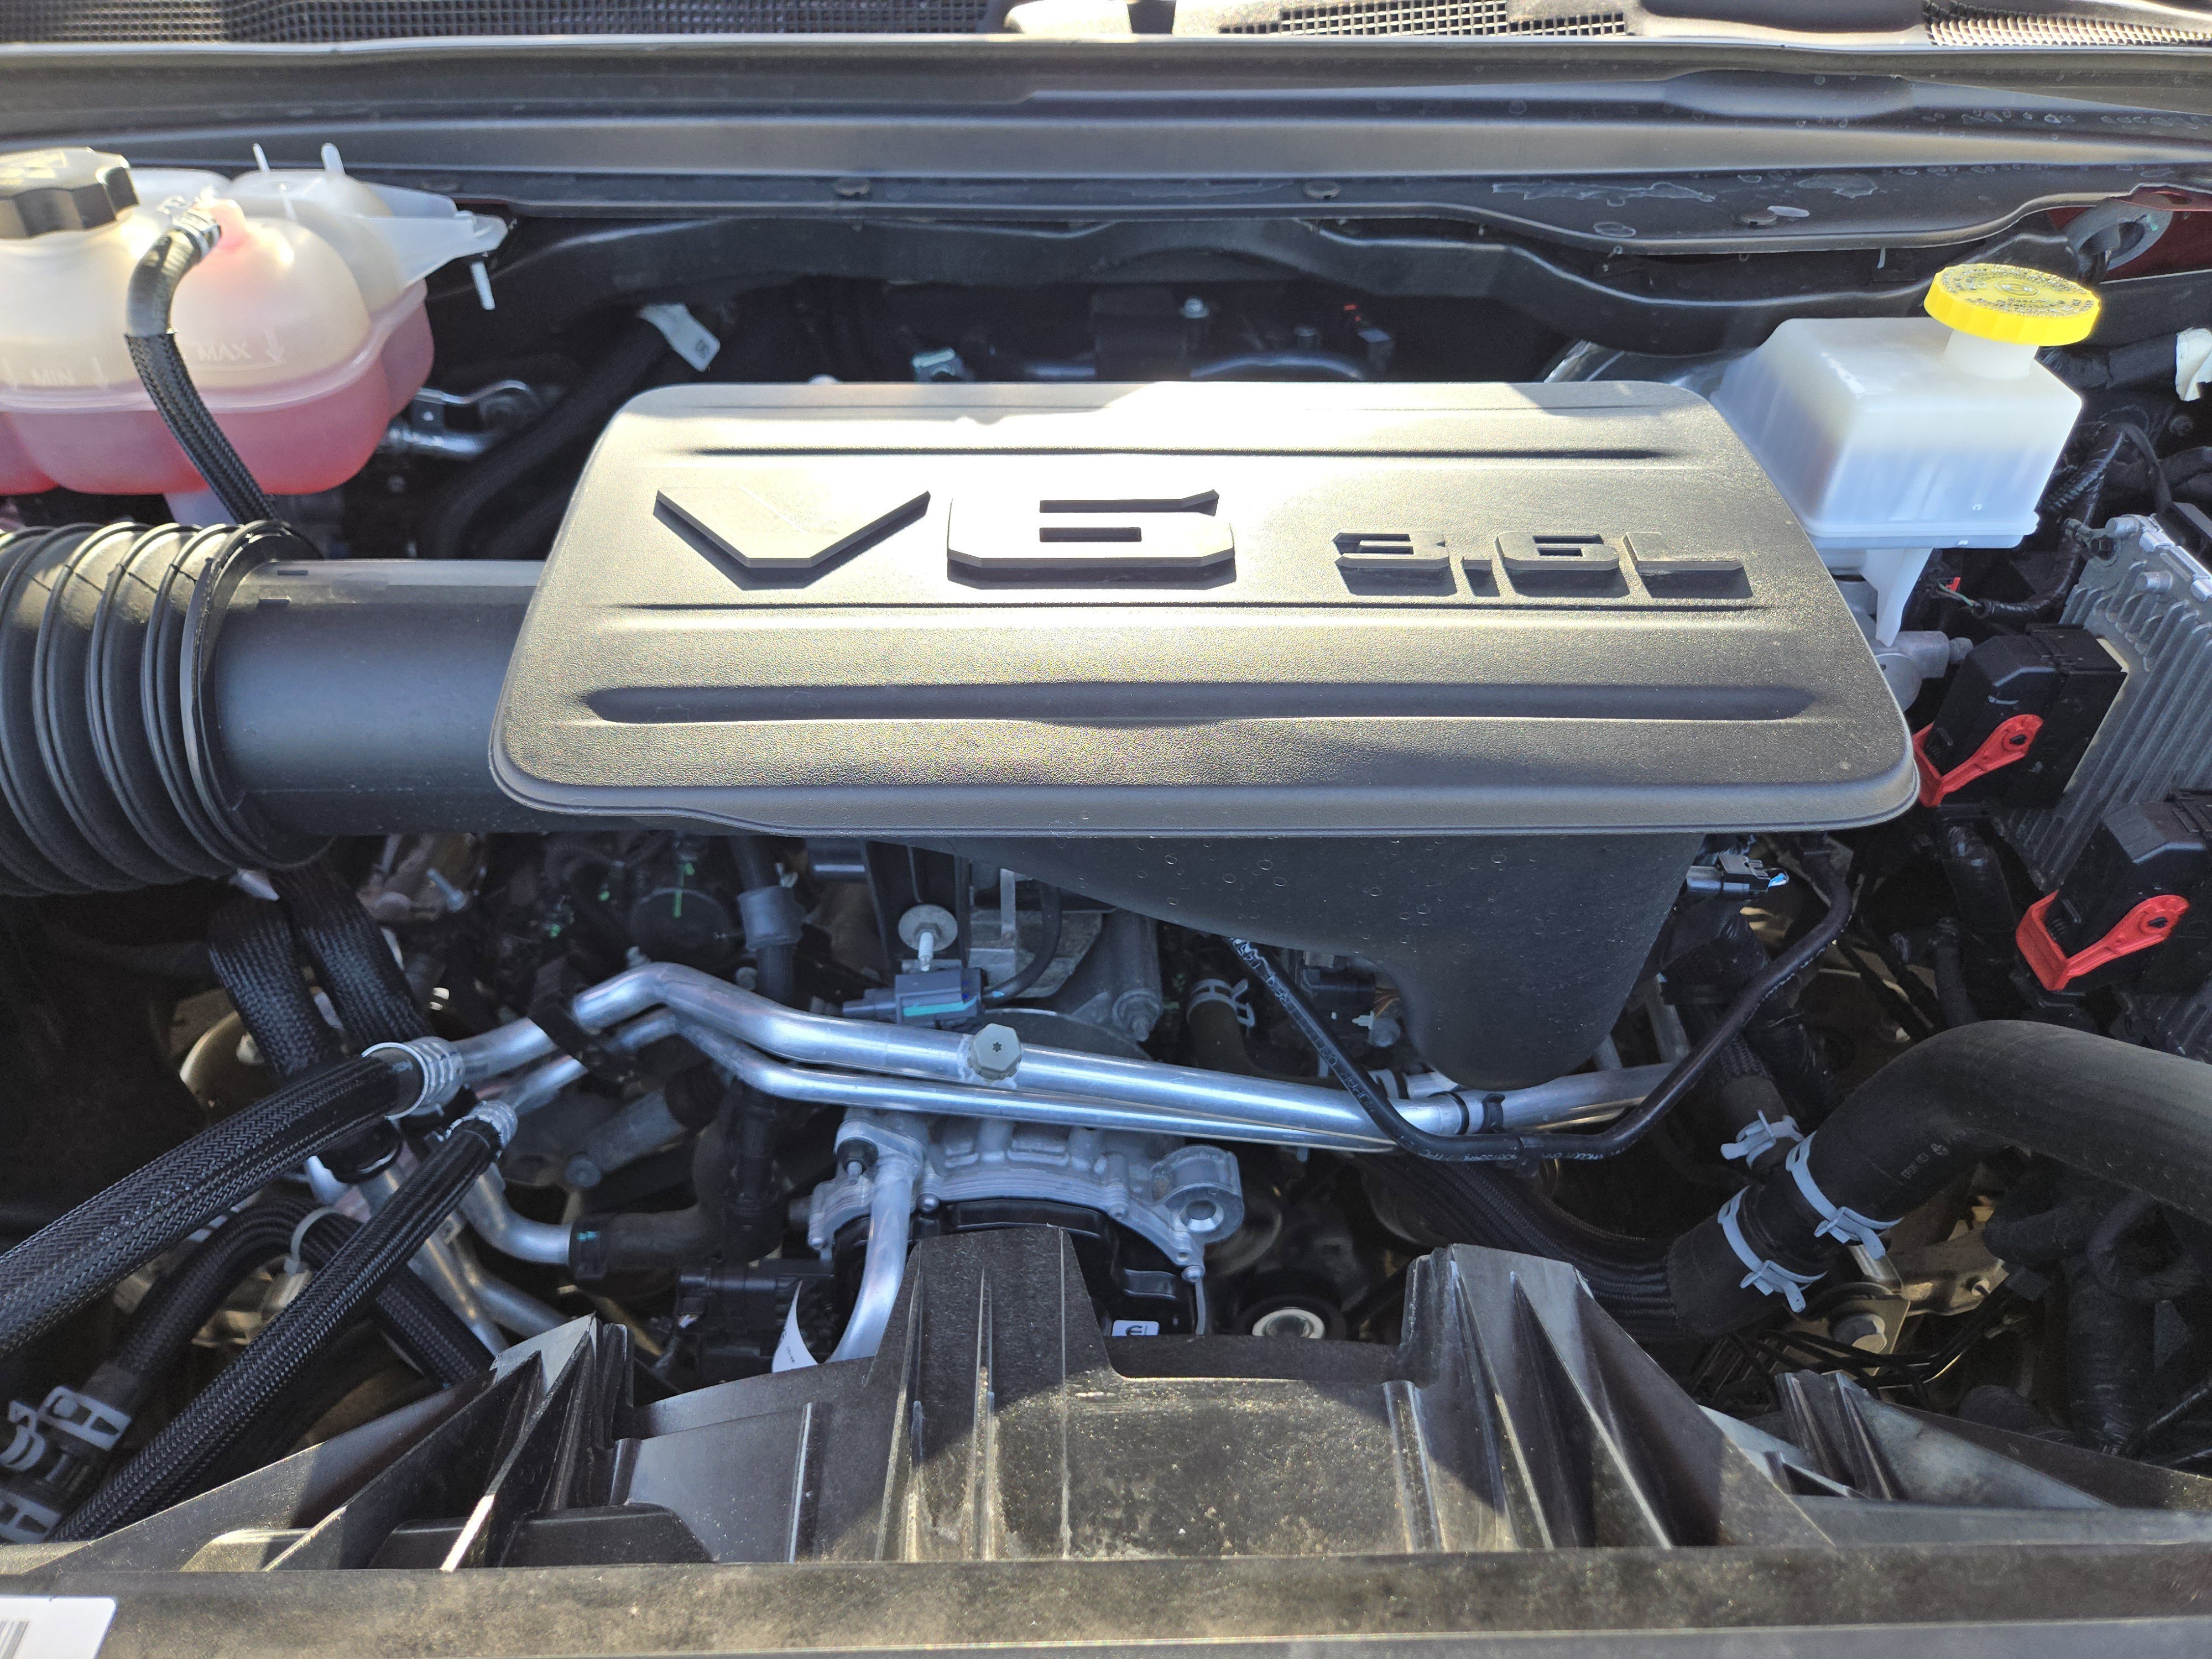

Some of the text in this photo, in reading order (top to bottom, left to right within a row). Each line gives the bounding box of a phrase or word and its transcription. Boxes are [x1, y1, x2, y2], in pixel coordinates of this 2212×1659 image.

[197, 341, 252, 361] MAX
[32, 367, 76, 386] MIN
[655, 486, 1746, 576] V6 3.6L
